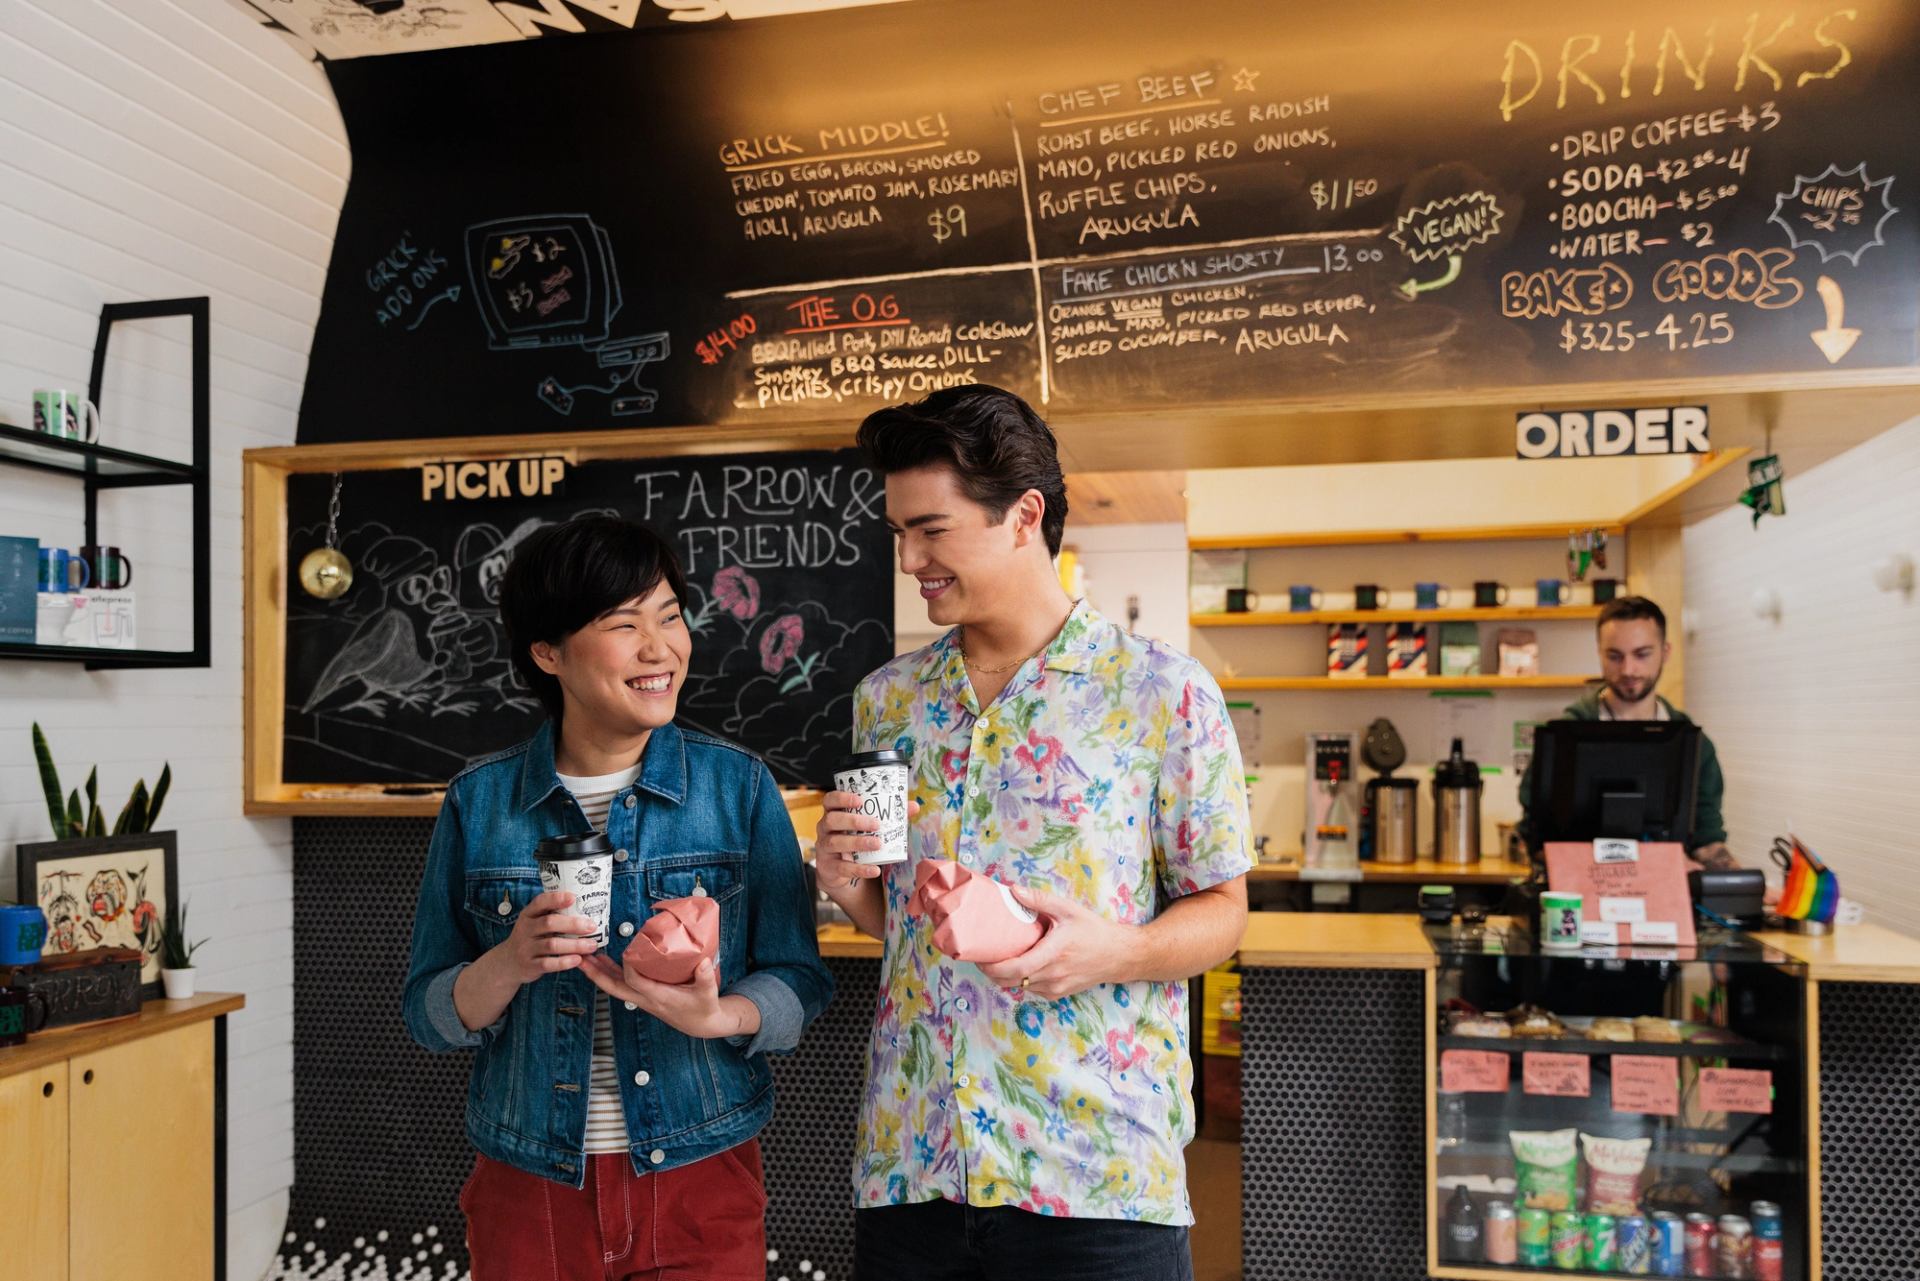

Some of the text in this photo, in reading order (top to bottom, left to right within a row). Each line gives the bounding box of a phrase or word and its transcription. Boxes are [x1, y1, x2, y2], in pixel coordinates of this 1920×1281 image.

[1499, 8, 1857, 121] DRINKS
[1038, 71, 1215, 114] CHEF BEEF
[719, 112, 950, 167] GRICK MIDDLE!
[1037, 127, 1092, 156] ROAST
[1169, 109, 1235, 136] HORSE
[1249, 94, 1330, 123] RADISH
[1563, 126, 1625, 161] DRIP
[731, 169, 785, 196] FRIED
[906, 149, 981, 173] SMOKED
[1107, 147, 1186, 173] PICKLED
[1195, 140, 1239, 163] RED
[807, 185, 876, 209] TOMATO
[928, 167, 1019, 196] ROSEMARY
[1038, 181, 1126, 219] RUFFLE
[1802, 185, 1864, 211] CHIPS
[803, 206, 882, 236] ARUGULA
[928, 204, 967, 244] $9
[1078, 203, 1200, 245] ARUGULA
[1414, 206, 1487, 244] VEGAN!
[1681, 222, 1715, 248] $2
[1062, 267, 1115, 296] FAKE
[1203, 246, 1285, 275] SHORTY
[1501, 247, 1803, 319] BAKED GOODS
[787, 295, 840, 328] THE
[1051, 319, 1120, 343] SAMBAL
[1177, 307, 1250, 327] PICKLED
[1258, 302, 1298, 319] RED
[1111, 296, 1163, 313] VEGAN
[1055, 340, 1112, 363] SLICED
[1235, 323, 1349, 355] ARUGULA
[830, 356, 875, 377] BBQ
[1516, 407, 1709, 458] ORDER
[423, 458, 565, 501] PICK UP
[635, 466, 886, 521] FARROW &
[678, 520, 861, 574] FRIENDS
